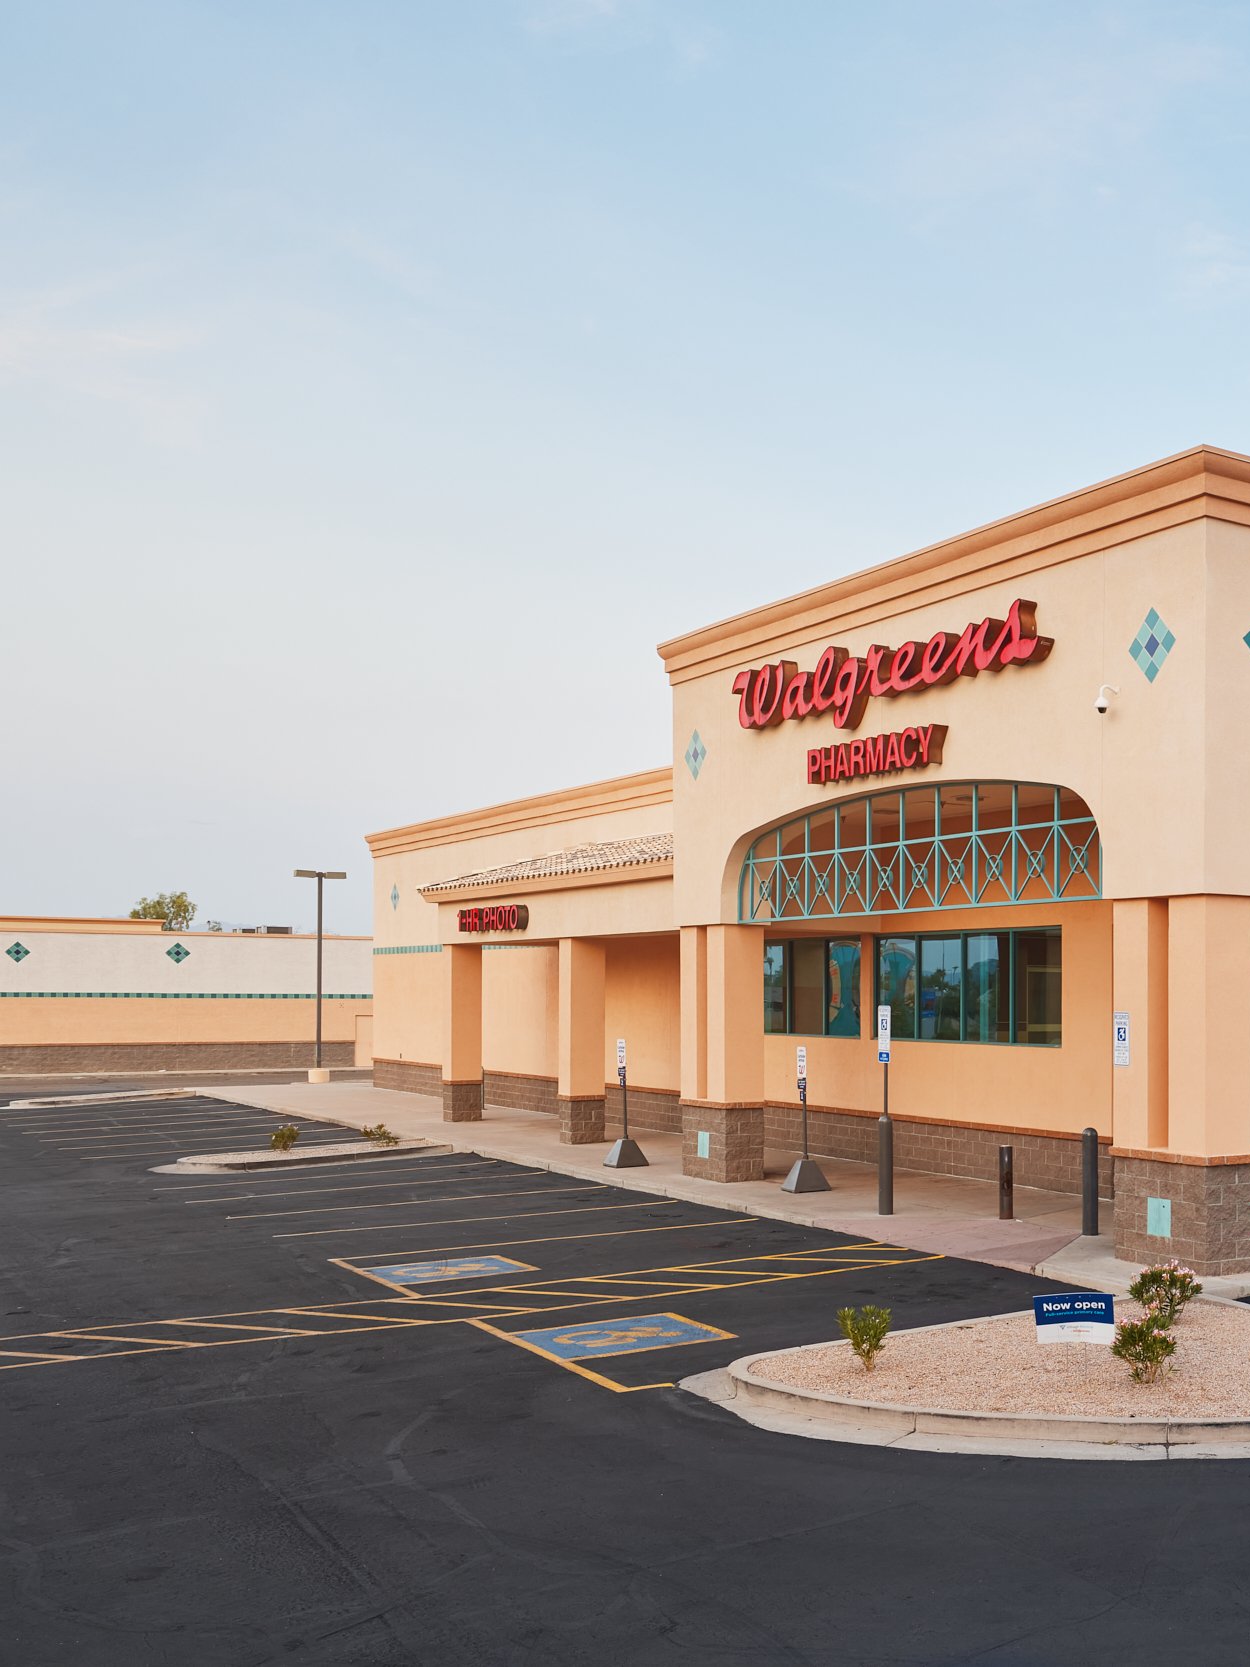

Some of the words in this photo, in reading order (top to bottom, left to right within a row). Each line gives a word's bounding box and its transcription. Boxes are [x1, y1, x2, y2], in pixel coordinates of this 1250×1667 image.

[732, 599, 1050, 730] Walgreens
[807, 724, 941, 784] PHARMACY
[457, 908, 479, 932] 1-HR
[482, 905, 521, 931] PHOTO
[1043, 1302, 1071, 1311] Now
[1074, 1301, 1106, 1310] open
